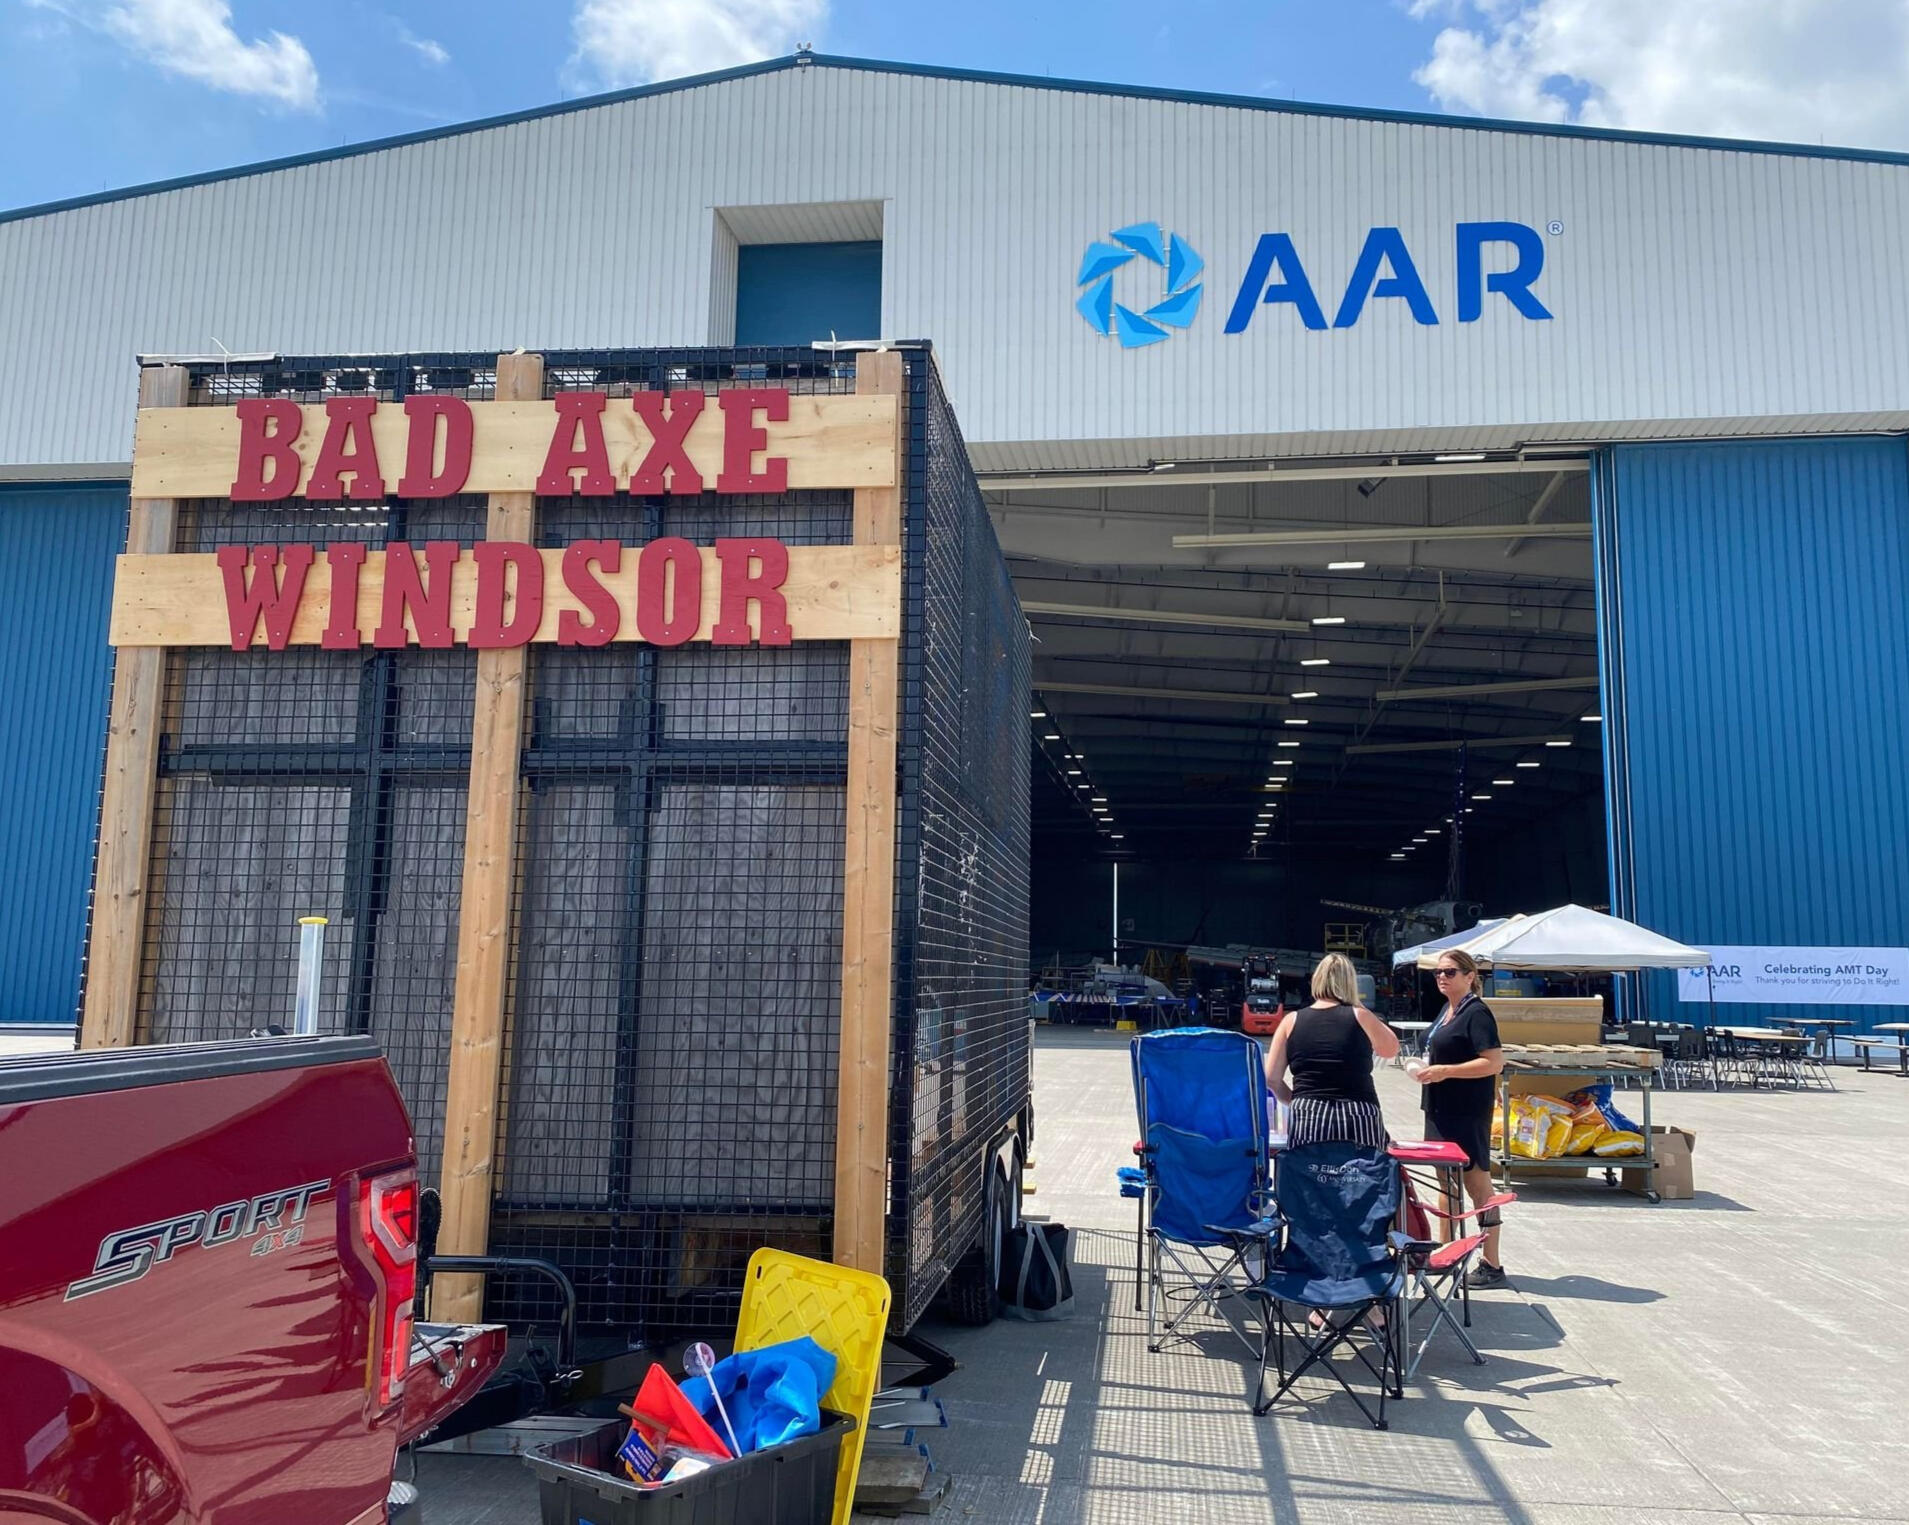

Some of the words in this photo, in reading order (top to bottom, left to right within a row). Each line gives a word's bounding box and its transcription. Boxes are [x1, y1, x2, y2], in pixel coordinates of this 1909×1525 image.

[230, 394, 474, 502] BAD
[536, 388, 790, 497] AXE
[217, 536, 793, 651] WINDSOR
[1755, 976, 1778, 985] Thank
[1781, 978, 1796, 986] you
[1798, 976, 1809, 985] for
[1811, 976, 1841, 987] striving
[1843, 977, 1853, 985] to
[1854, 977, 1866, 985] Do
[1764, 963, 1831, 977] Celebrating
[1835, 965, 1862, 975] AMT
[1866, 965, 1889, 978] Day
[63, 1178, 332, 1303] SPORT
